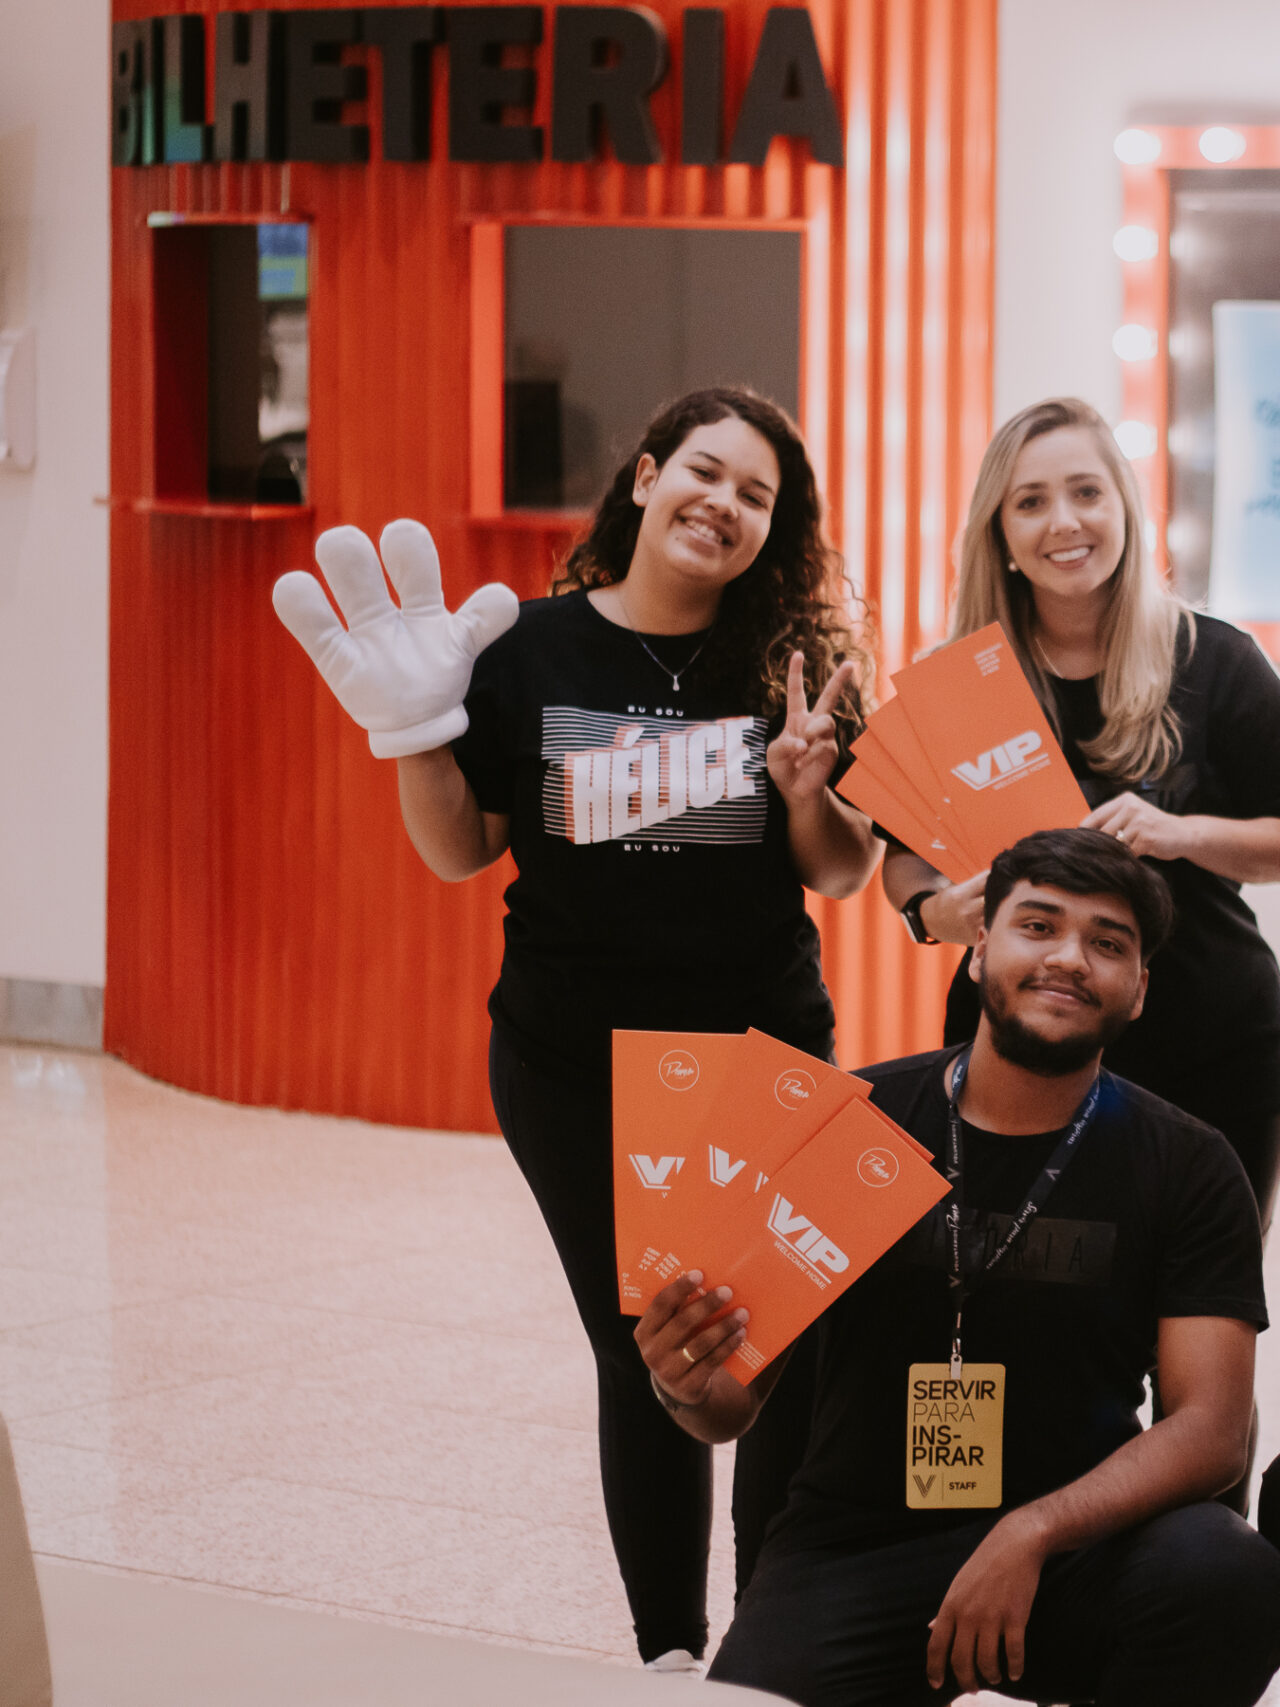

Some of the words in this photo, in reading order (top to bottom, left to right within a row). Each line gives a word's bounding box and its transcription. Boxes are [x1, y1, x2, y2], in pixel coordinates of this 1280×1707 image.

[112, 5, 844, 168] BILHETERIA
[952, 730, 1043, 788] VIP
[566, 715, 755, 844] HÉLICE
[768, 1194, 850, 1274] VIP
[773, 1239, 808, 1273] WELCOME
[804, 1268, 828, 1291] HOME
[912, 1379, 997, 1401] SERVIR
[913, 1401, 976, 1423] PARA
[912, 1424, 962, 1446] INS-
[912, 1445, 985, 1467] PIRAR
[948, 1481, 977, 1491] STAFF
